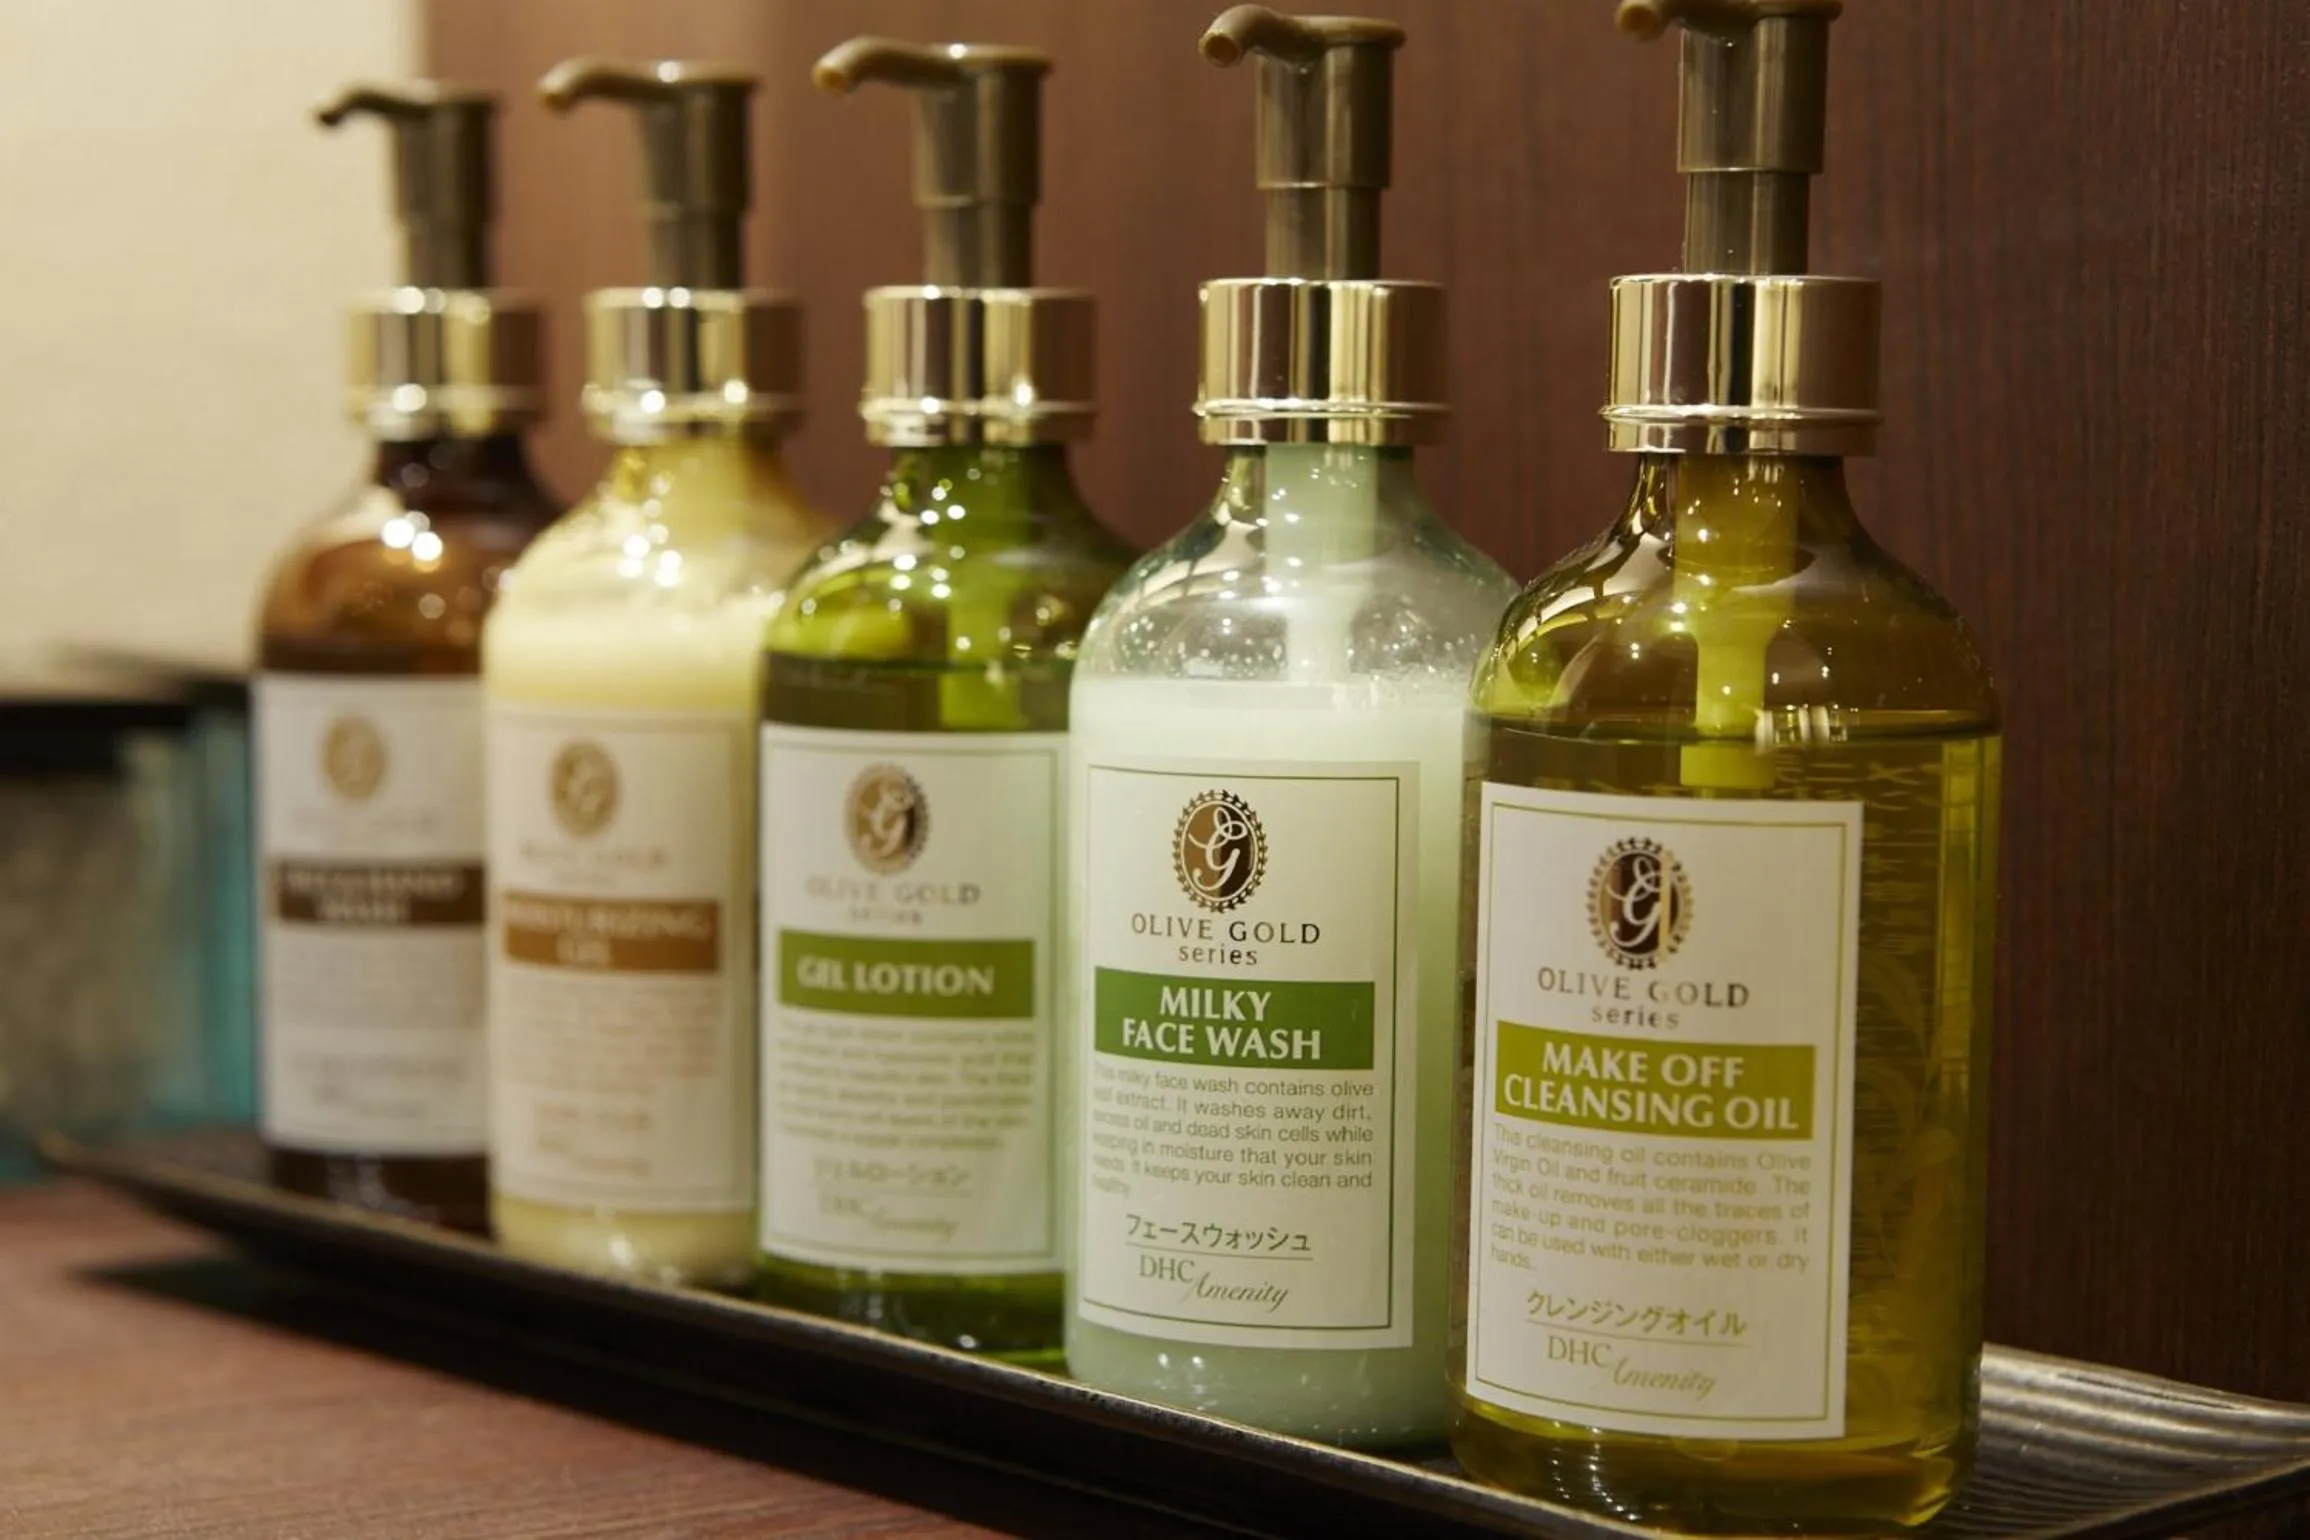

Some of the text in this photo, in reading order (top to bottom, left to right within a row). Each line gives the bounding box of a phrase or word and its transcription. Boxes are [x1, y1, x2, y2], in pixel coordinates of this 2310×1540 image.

[1132, 912, 1321, 945] OLIVE GOLD
[1179, 943, 1258, 966] series
[853, 961, 995, 997] LOTION
[1538, 966, 1750, 1010] OLIVE GOLD
[1160, 985, 1272, 1022] MILKY
[1591, 1006, 1680, 1030] series
[1122, 1017, 1322, 1061] FACE WASH
[1543, 1041, 1745, 1090] MAKE OFF
[1155, 1072, 1188, 1090] face
[1193, 1077, 1239, 1094] wash
[1244, 1079, 1325, 1098] contains
[1331, 1080, 1374, 1097] olive
[1503, 1073, 1800, 1131] CLEANSING OIL
[1177, 1096, 1188, 1114] It
[1195, 1100, 1266, 1119] washes
[1273, 1106, 1326, 1124] away
[1333, 1104, 1373, 1121] dirt.
[1134, 1116, 1149, 1130] oil
[1153, 1119, 1182, 1135] and
[1187, 1121, 1230, 1139] dead
[1235, 1124, 1272, 1142] skin
[1278, 1126, 1320, 1142] cells
[1325, 1126, 1374, 1142] while
[1142, 1138, 1155, 1154] in
[1160, 1143, 1234, 1163] moisture
[1241, 1147, 1277, 1165] that
[1284, 1152, 1327, 1169] your
[1333, 1149, 1373, 1166] skin
[1526, 1133, 1614, 1164] cleansing
[1620, 1147, 1646, 1163] oil
[1653, 1151, 1749, 1170] contains
[1756, 1152, 1812, 1171] Olive
[1145, 1161, 1190, 1183] keeps
[1195, 1168, 1233, 1186] your
[1238, 1170, 1275, 1187] skin
[1281, 1171, 1331, 1188] clean
[1336, 1171, 1373, 1188] and
[1537, 1157, 1560, 1178] Oil
[1565, 1166, 1600, 1183] and
[1607, 1167, 1647, 1189] fruit
[1773, 1175, 1812, 1196] The
[1492, 1199, 1561, 1229] make-up
[1568, 1215, 1606, 1233] and
[1529, 1183, 1548, 1200] oil
[1553, 1189, 1635, 1212] removes
[1642, 1198, 1667, 1215] all
[1673, 1198, 1707, 1218] the
[1714, 1201, 1782, 1221] traces
[1790, 1201, 1811, 1220] of
[1126, 1214, 1312, 1252] フェースウォッシュ
[1491, 1222, 1811, 1274] can be used with either wet or dry
[1139, 1254, 1196, 1283] DHC
[1527, 1289, 1748, 1337] クレンジングオイル
[1547, 1334, 1612, 1369] DHC
